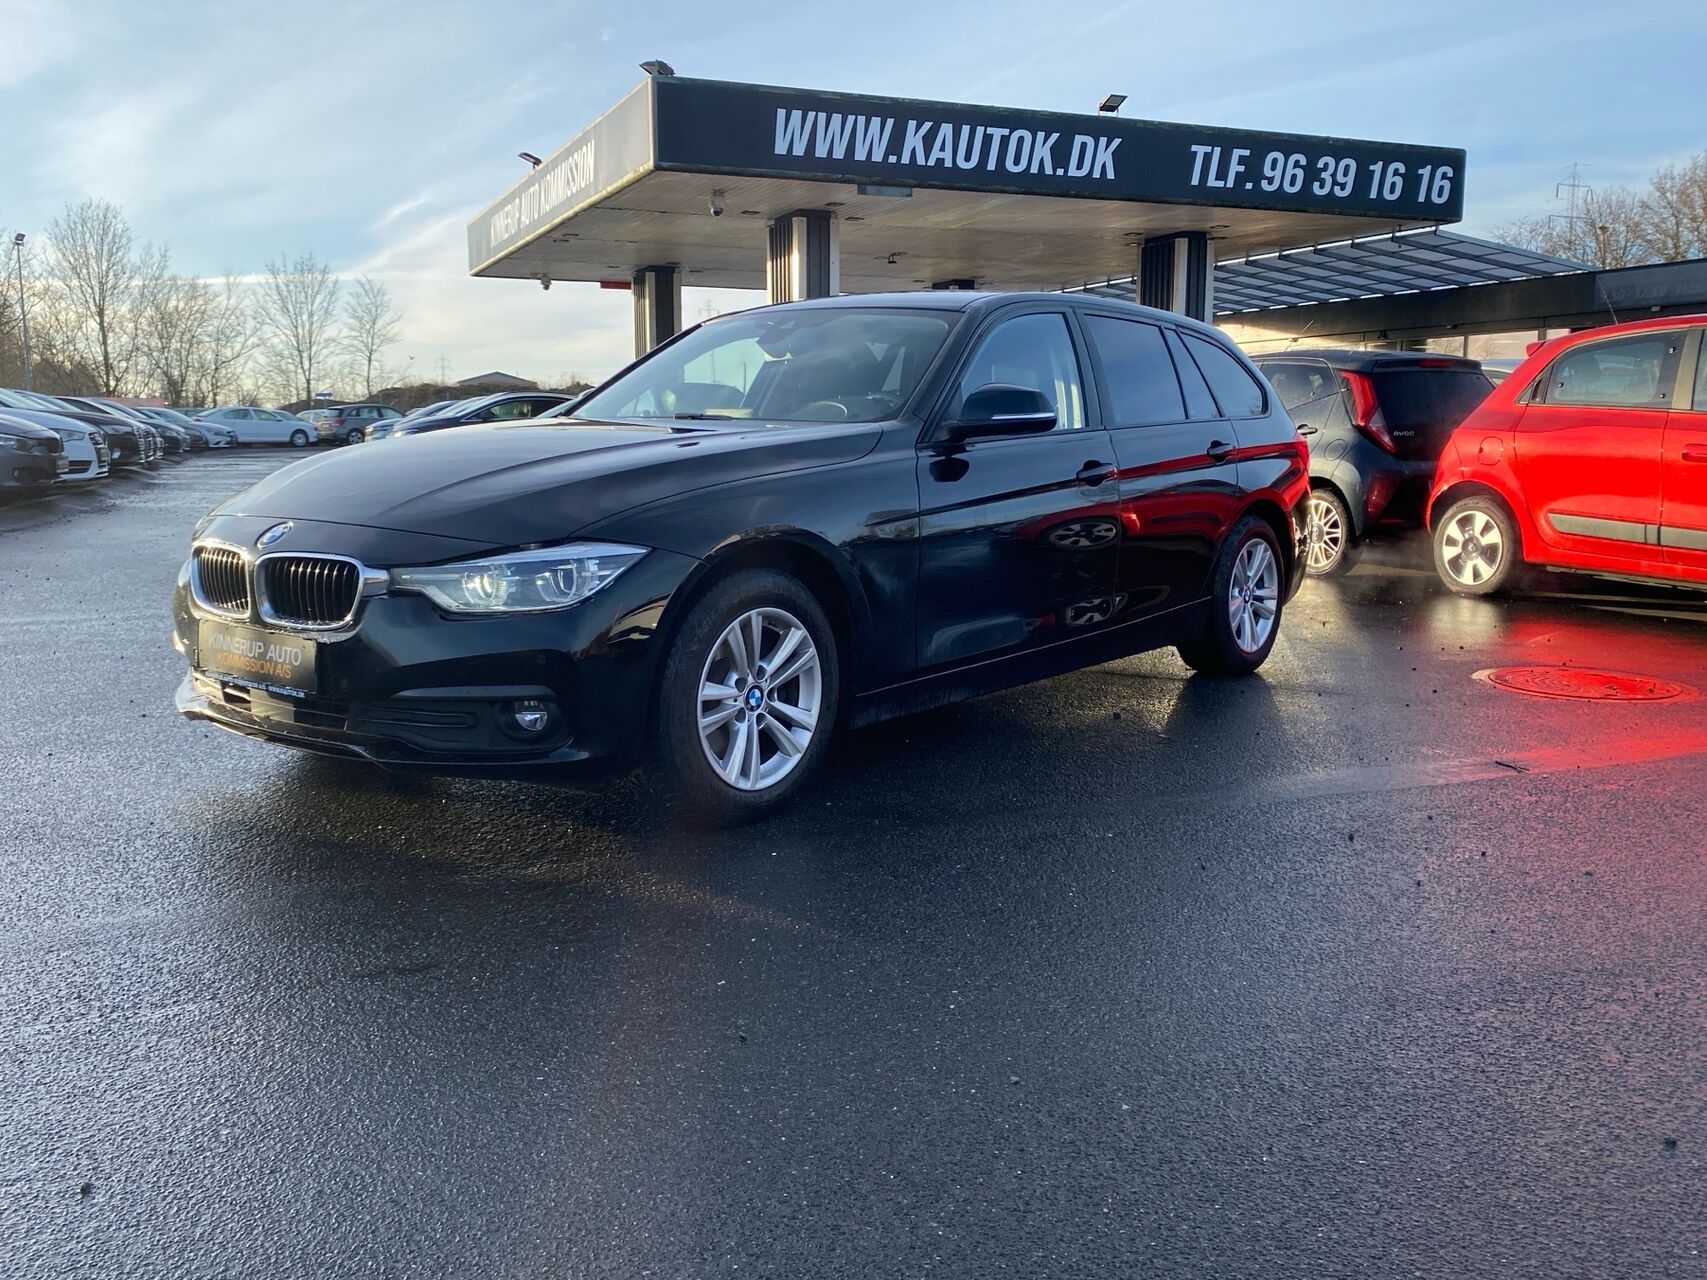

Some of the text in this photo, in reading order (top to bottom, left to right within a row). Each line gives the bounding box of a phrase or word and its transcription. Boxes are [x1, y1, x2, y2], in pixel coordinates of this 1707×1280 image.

[774, 107, 1123, 180] WWW.KAUTOK.DK
[540, 140, 594, 216] KOMMISSION
[1190, 144, 1454, 205] TLF. 96 39 16 16
[209, 632, 302, 666] KINNERUP AUTO
[216, 650, 274, 675] KOMMISSION
